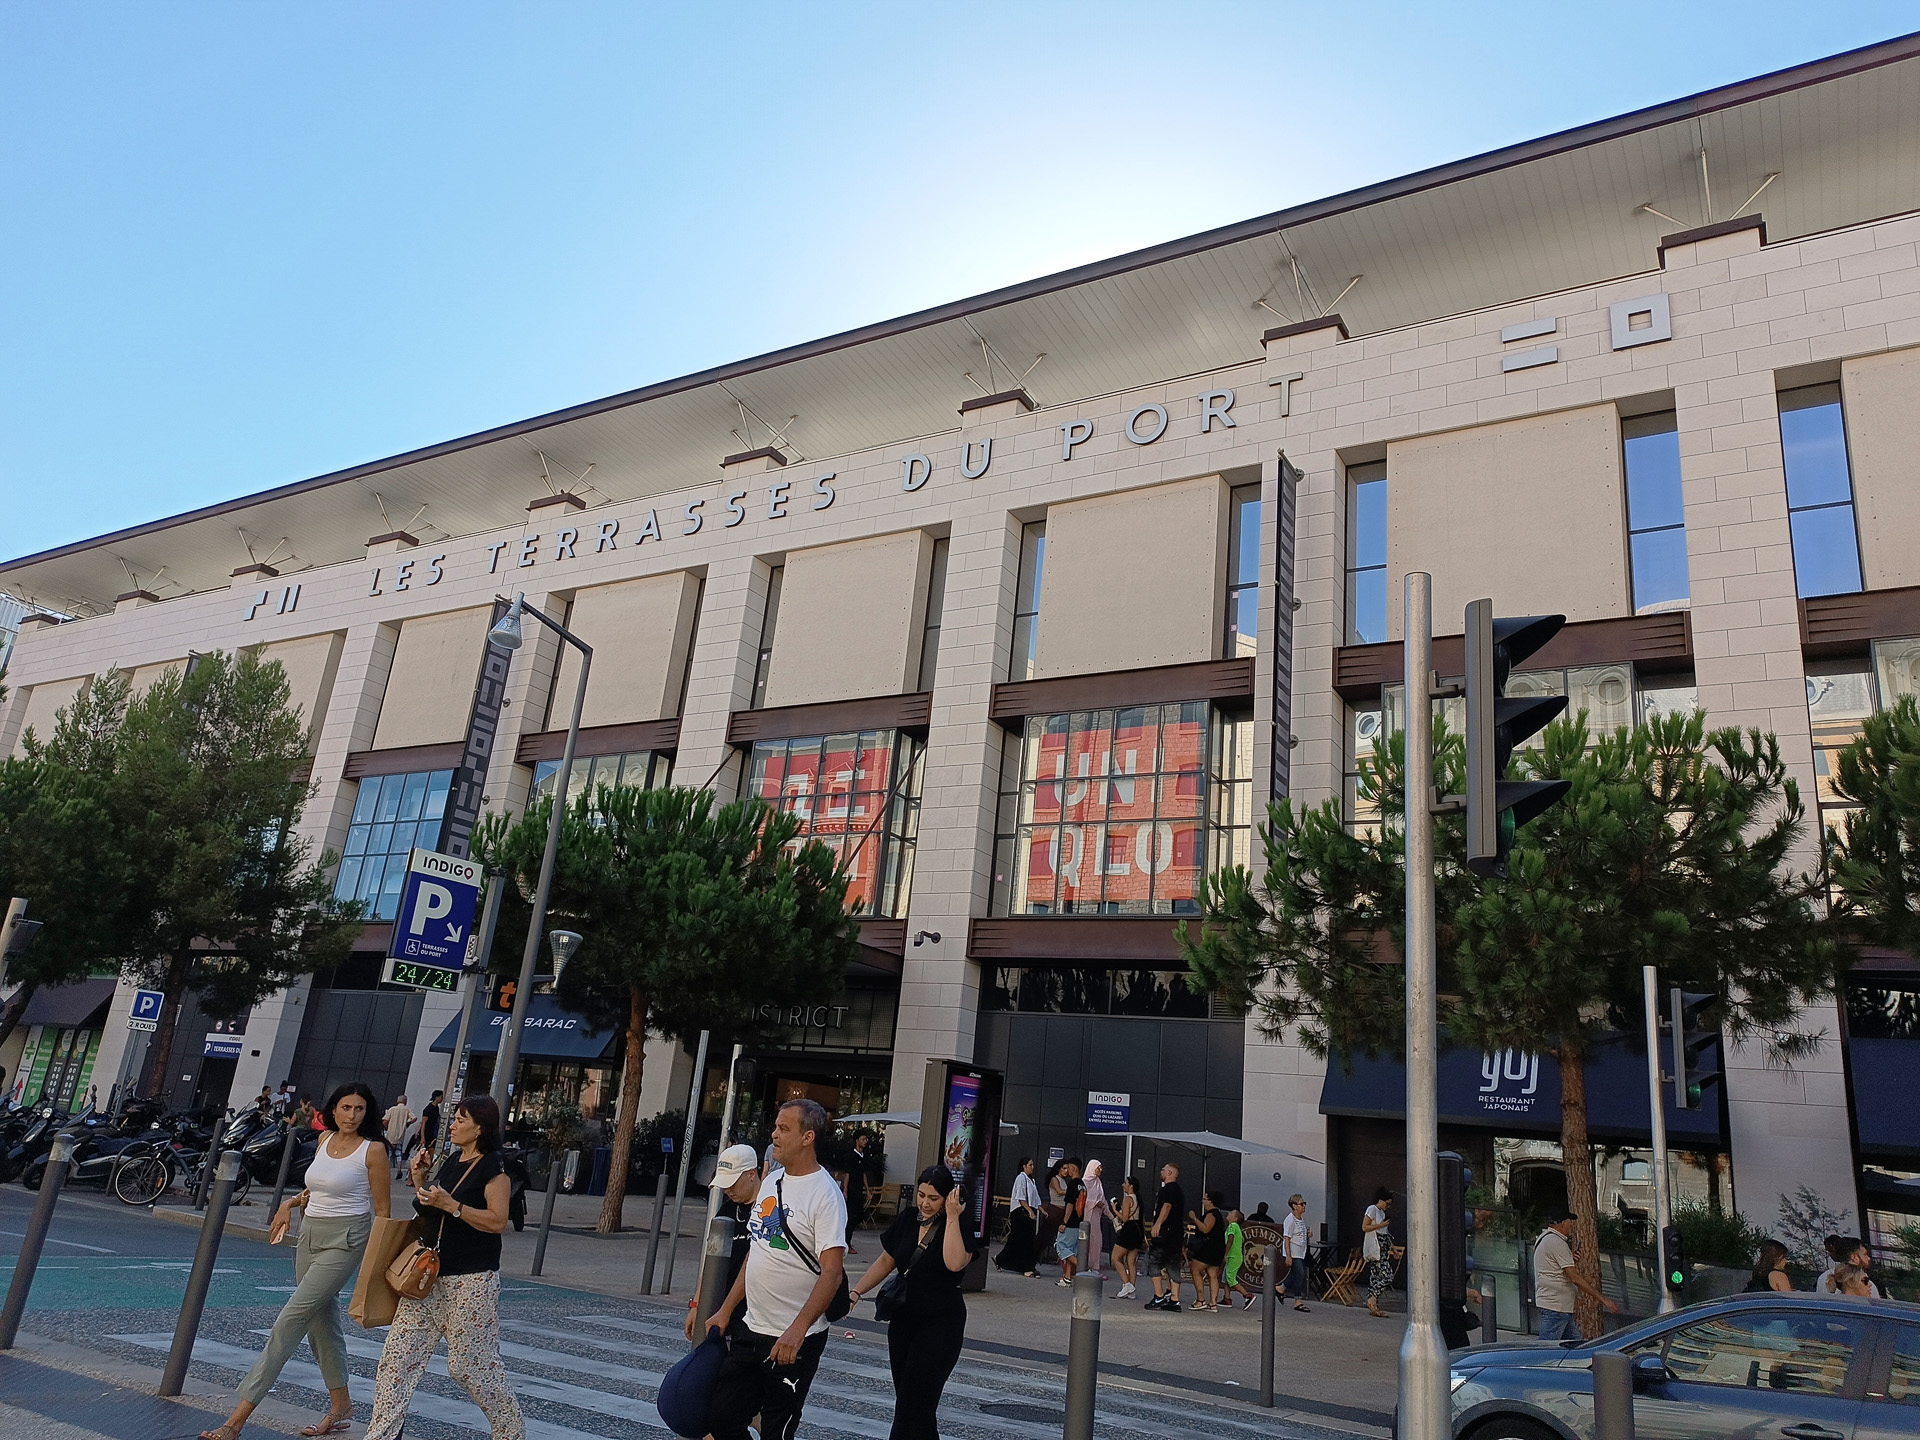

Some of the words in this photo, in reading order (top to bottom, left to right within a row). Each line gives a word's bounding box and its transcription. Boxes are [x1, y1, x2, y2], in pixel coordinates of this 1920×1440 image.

[368, 554, 446, 597] LES
[487, 472, 836, 573] TERRASSES
[902, 437, 993, 492] DU
[1061, 371, 1304, 461] PORT
[1054, 747, 1165, 806] UNI
[1049, 822, 1173, 887] QLO
[423, 856, 474, 880] INDIGO
[409, 880, 453, 936] P
[421, 943, 449, 953] TERRASSES
[429, 950, 442, 958] PORT
[139, 996, 155, 1013] P
[490, 1016, 577, 1029] BABARAC
[751, 1004, 849, 1028] ISTRICT
[135, 1022, 156, 1031] ROUES
[204, 1043, 211, 1054] P
[1095, 1094, 1122, 1103] INDIGO
[1478, 1095, 1535, 1105] RESTAURANT
[1483, 1103, 1529, 1112] JAPONAIS
